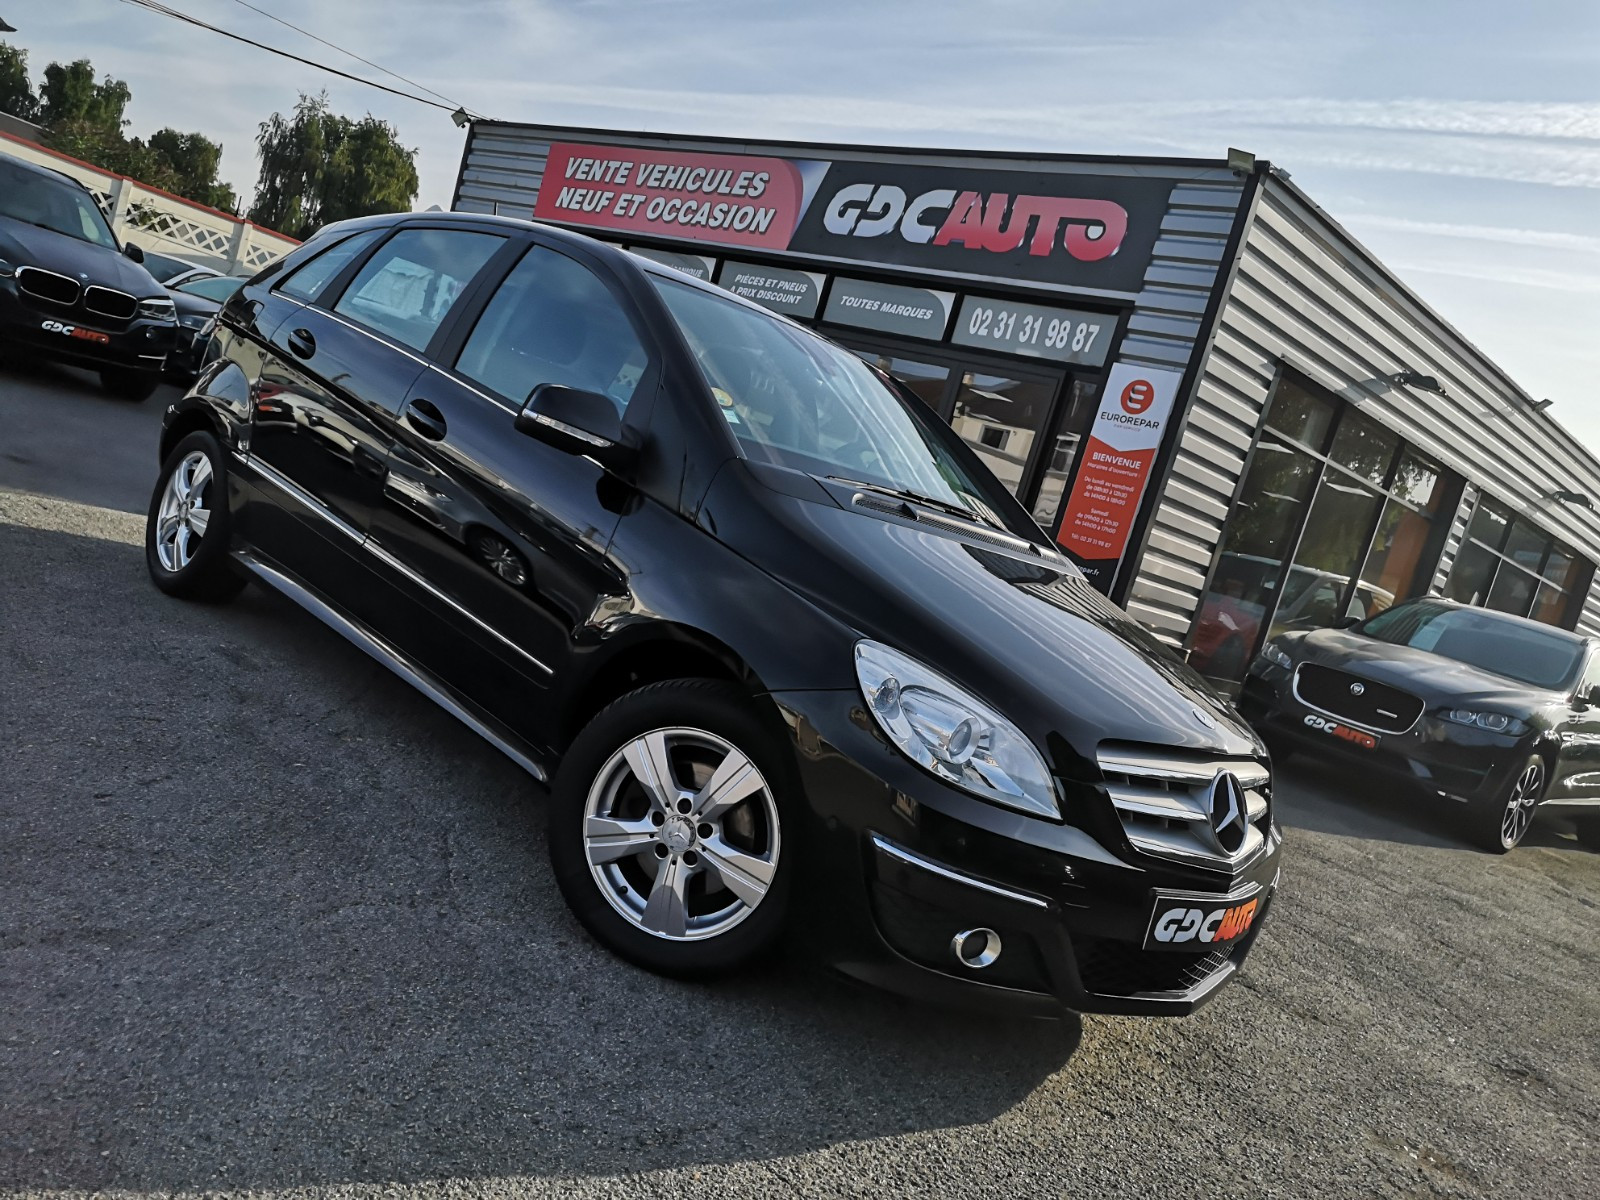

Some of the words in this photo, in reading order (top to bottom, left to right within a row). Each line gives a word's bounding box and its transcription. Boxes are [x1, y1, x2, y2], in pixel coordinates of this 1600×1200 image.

[563, 156, 633, 184] VENTE
[635, 163, 770, 198] VEHICULES
[555, 186, 615, 213] NEUF
[612, 195, 646, 218] ET
[646, 197, 775, 234] OCCASION
[735, 273, 764, 287] PIÈCES
[765, 279, 778, 288] ET
[777, 281, 808, 293] PNEUS
[736, 287, 758, 298] PRIX
[757, 290, 802, 304] DISCOUNT
[840, 295, 880, 314] TOUTES
[880, 301, 933, 321] MARQUES
[969, 308, 989, 336] 02
[993, 312, 1016, 340] 31
[1018, 316, 1042, 345] 31
[1045, 320, 1070, 349] 98
[1072, 323, 1100, 353] 87
[1100, 411, 1160, 430] EUROREPAR
[1092, 451, 1142, 470] BIENVENUE
[1091, 508, 1109, 517] Samedi
